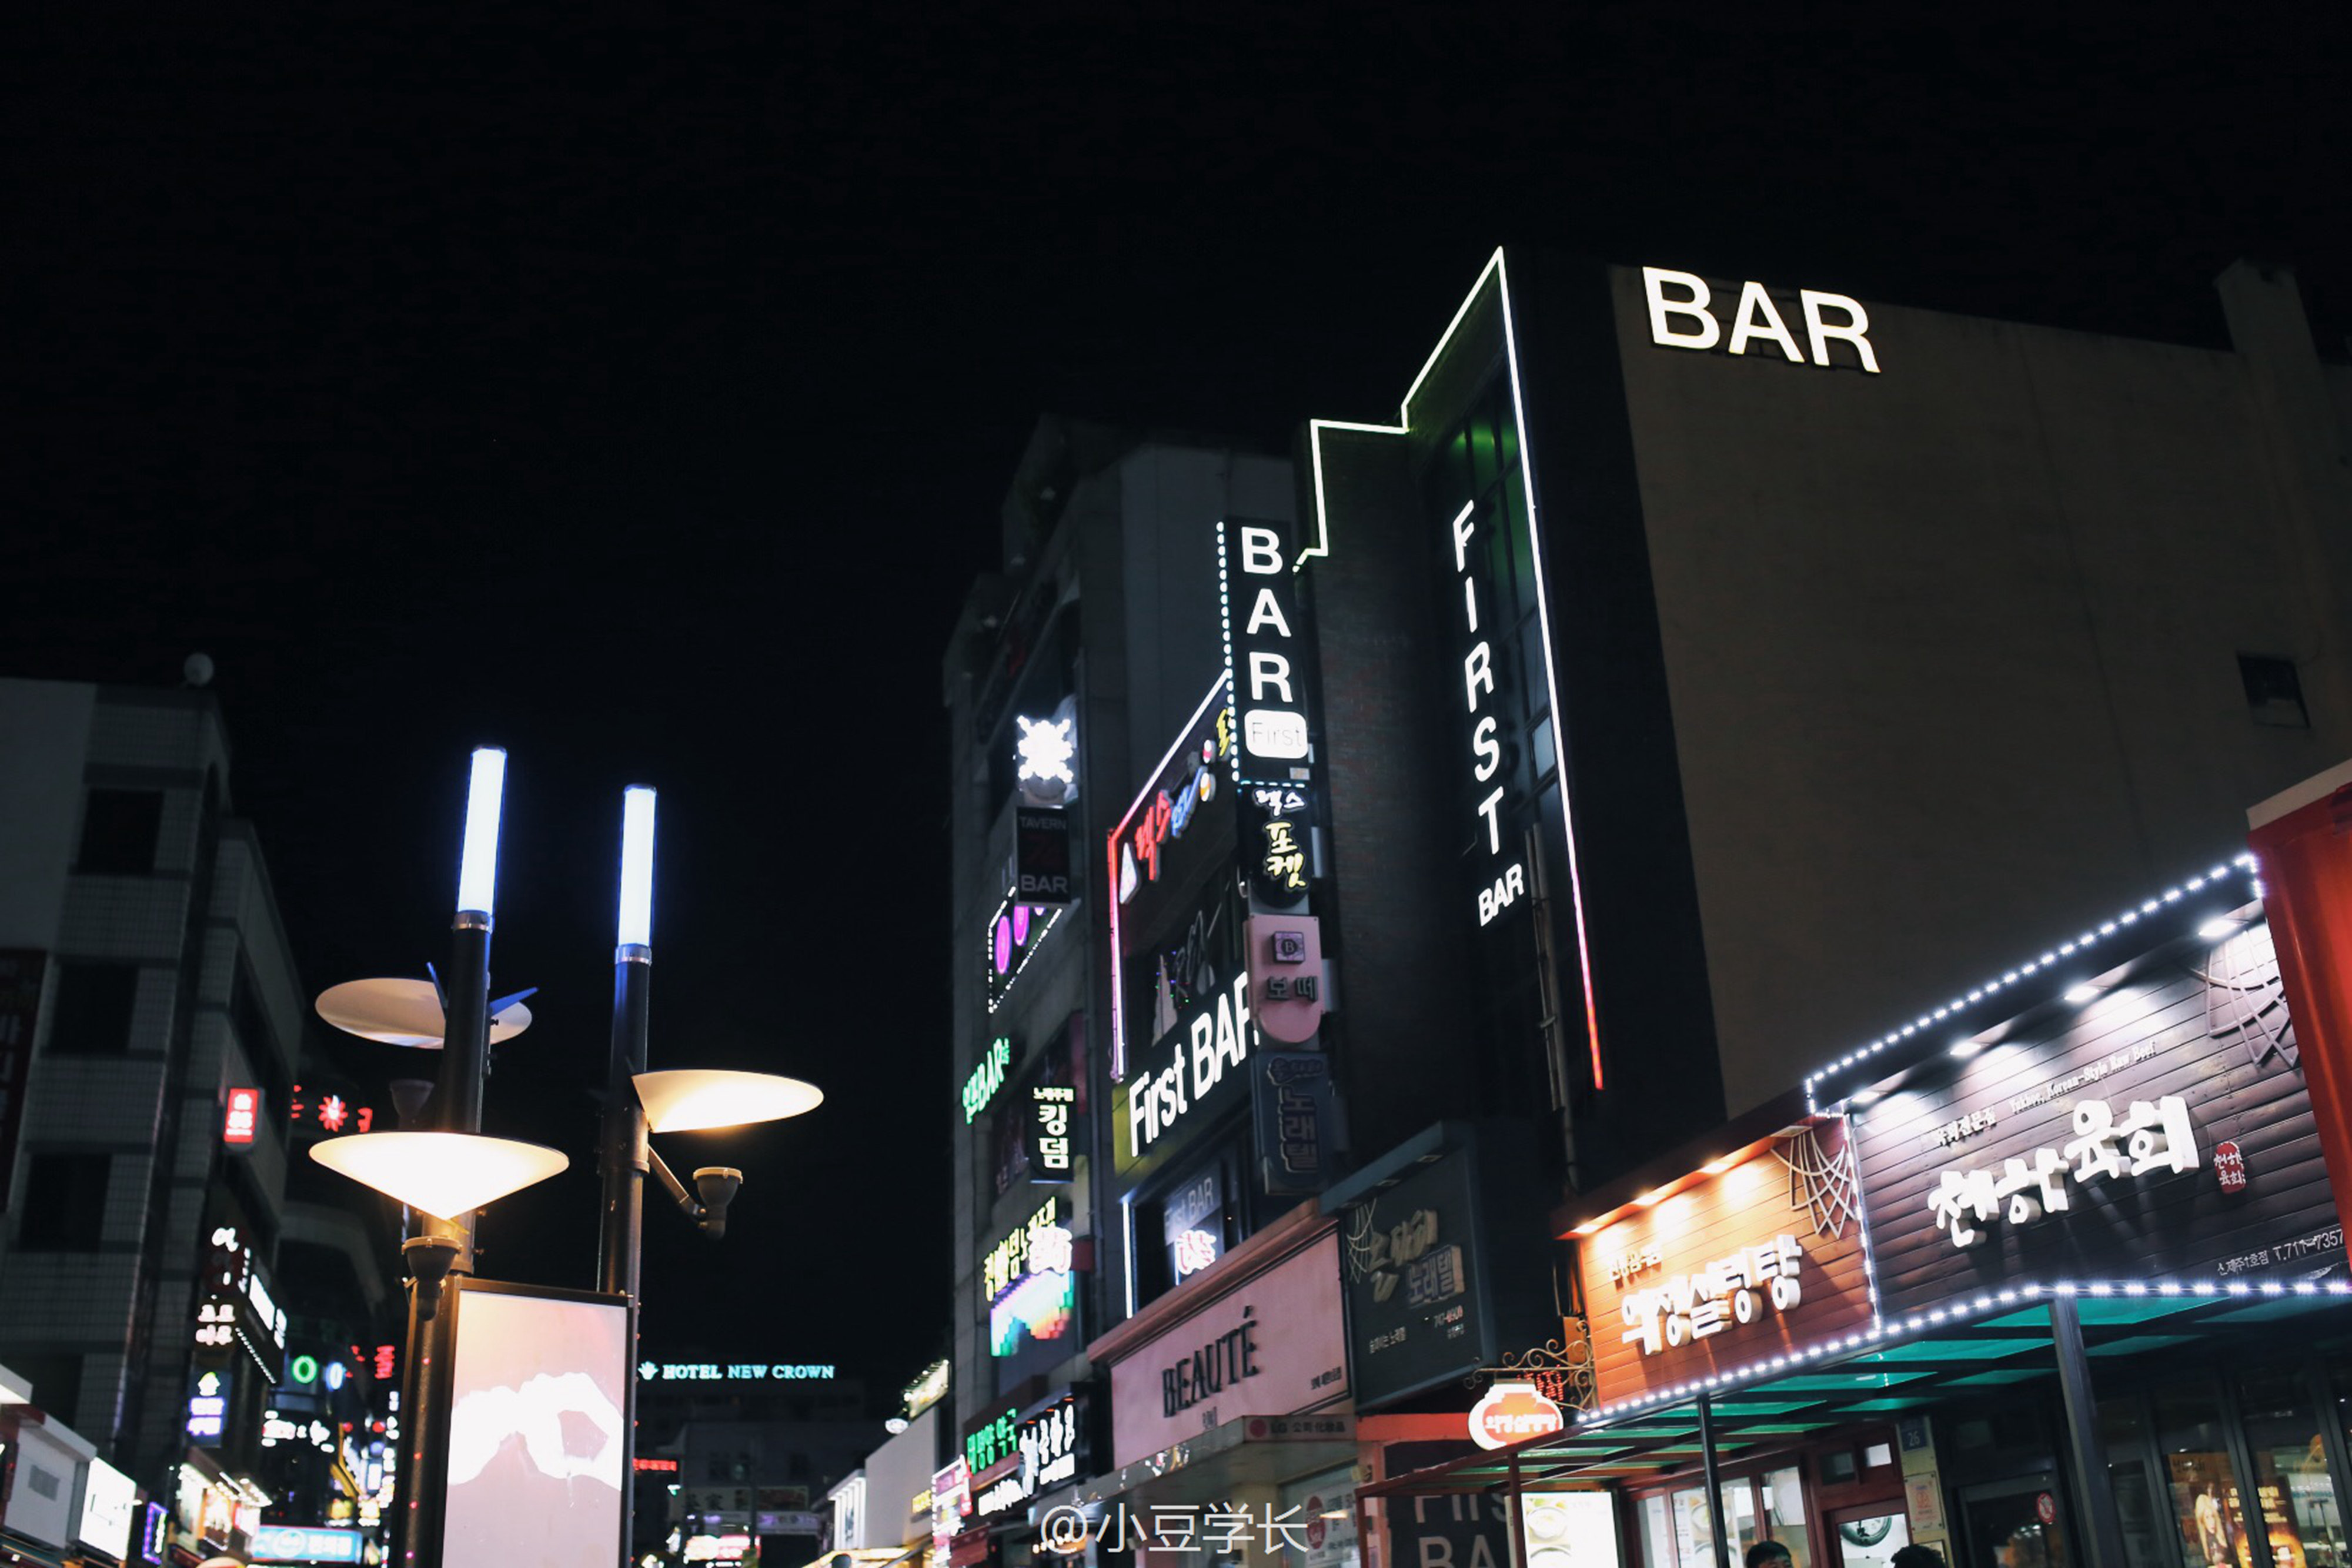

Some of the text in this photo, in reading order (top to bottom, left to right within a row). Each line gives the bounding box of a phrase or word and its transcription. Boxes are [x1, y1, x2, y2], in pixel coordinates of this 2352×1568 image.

[1642, 266, 1880, 373] BAR
[1241, 526, 1294, 703] BAR
[1453, 500, 1504, 855] FIRST
[1253, 721, 1303, 747] First
[1255, 790, 1305, 817] 맥스
[1018, 815, 1067, 830] TAVERN
[1265, 822, 1307, 888] 포켓
[1020, 874, 1068, 893] BAR
[1478, 863, 1524, 927] BAR
[1267, 975, 1318, 1001] 보떼
[2046, 1061, 2108, 1096] Korean-Style
[2108, 1055, 2130, 1072] Raw
[2131, 1041, 2154, 1062] Beef
[1128, 1044, 1188, 1158] First
[1038, 1104, 1069, 1169] 킹덤
[2214, 1152, 2242, 1169] 천하
[2219, 1169, 2243, 1185] 육회
[1188, 1176, 1214, 1222] BAR
[662, 1364, 835, 1380] HOTEL NEW CROWN
[1907, 1430, 1921, 1447] 26
